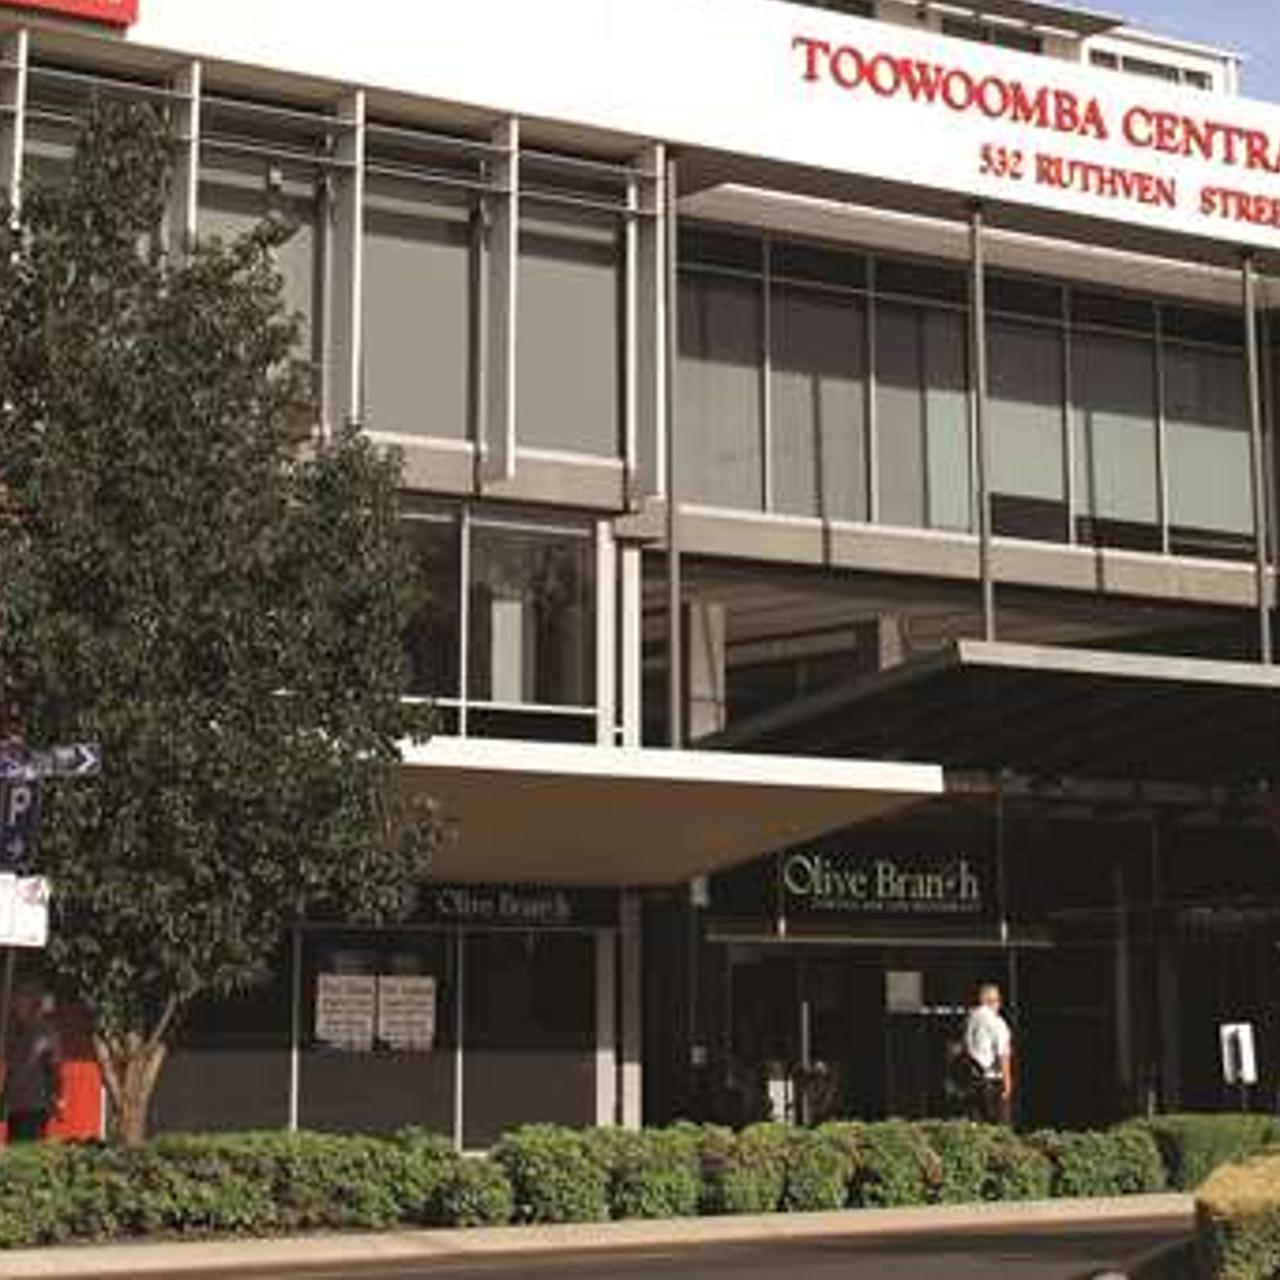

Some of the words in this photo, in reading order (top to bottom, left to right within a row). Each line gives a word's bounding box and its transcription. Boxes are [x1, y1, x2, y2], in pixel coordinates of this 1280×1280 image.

[793, 36, 1109, 141] TOOWOOMBA
[979, 144, 1024, 180] 532
[1035, 153, 1176, 208] RUTHVEN
[784, 853, 869, 896] Olive
